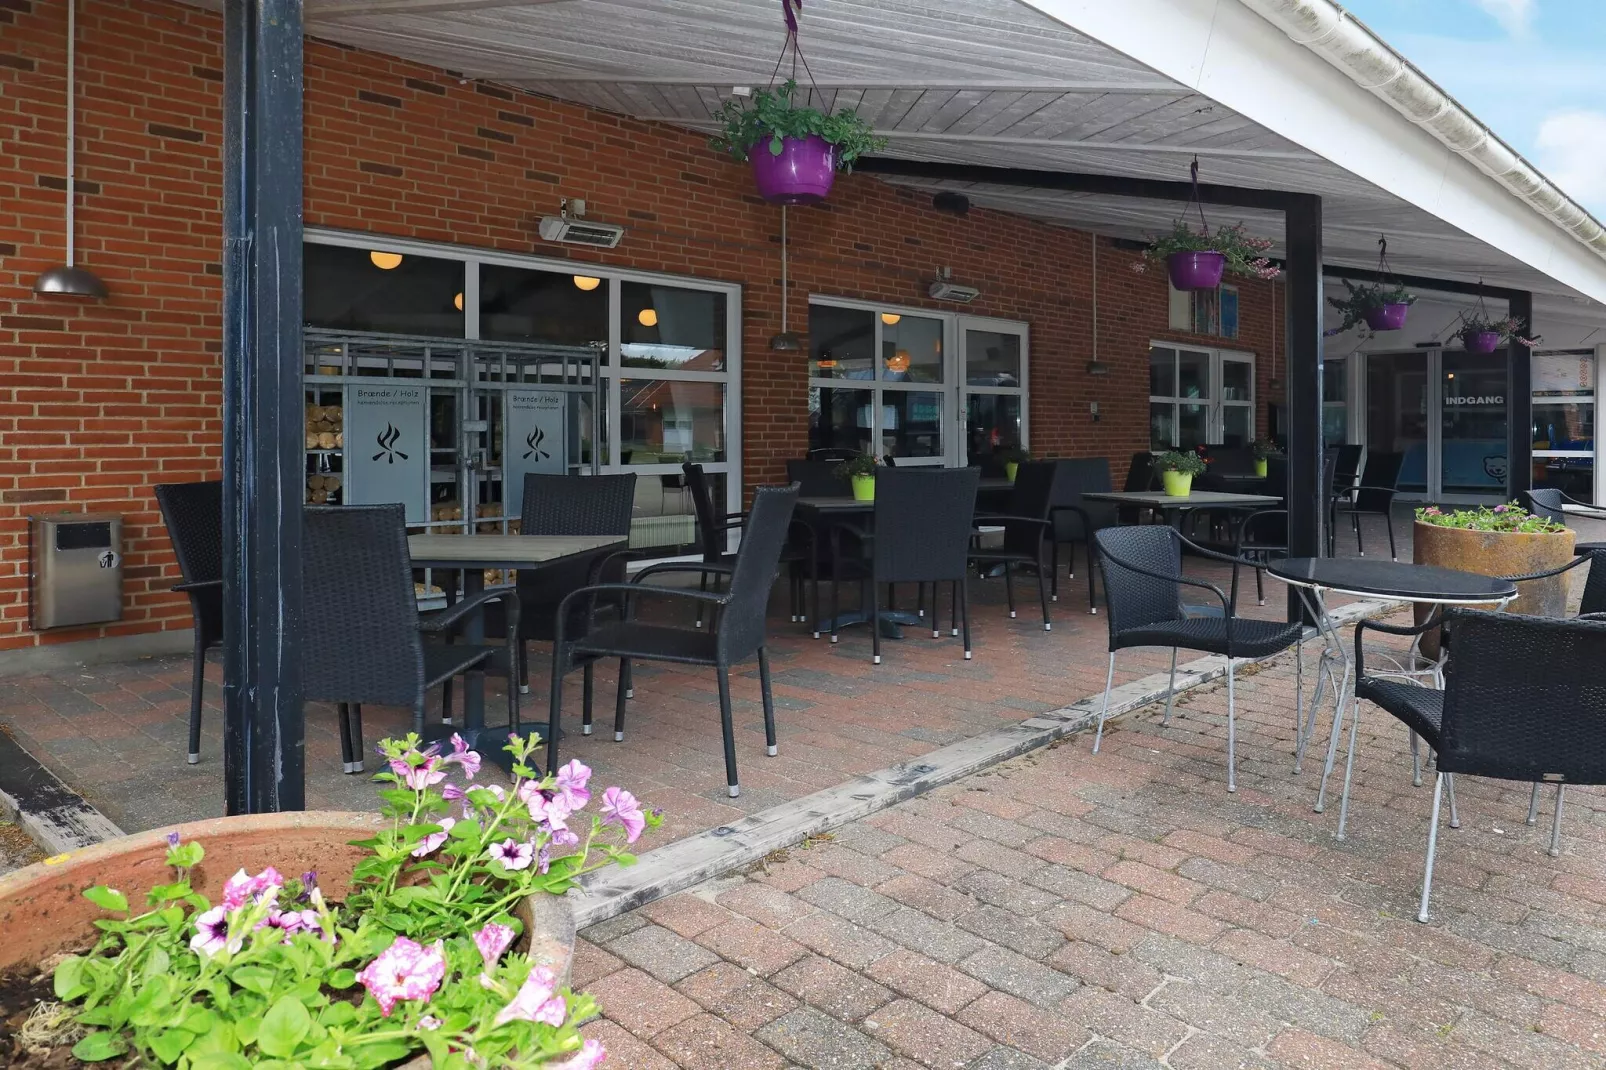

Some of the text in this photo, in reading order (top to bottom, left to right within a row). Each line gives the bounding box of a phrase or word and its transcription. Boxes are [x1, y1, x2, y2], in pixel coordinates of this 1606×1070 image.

[357, 389, 419, 398] Brænde / Holz
[544, 396, 559, 404] Holz
[1445, 395, 1504, 405] INDGANG
